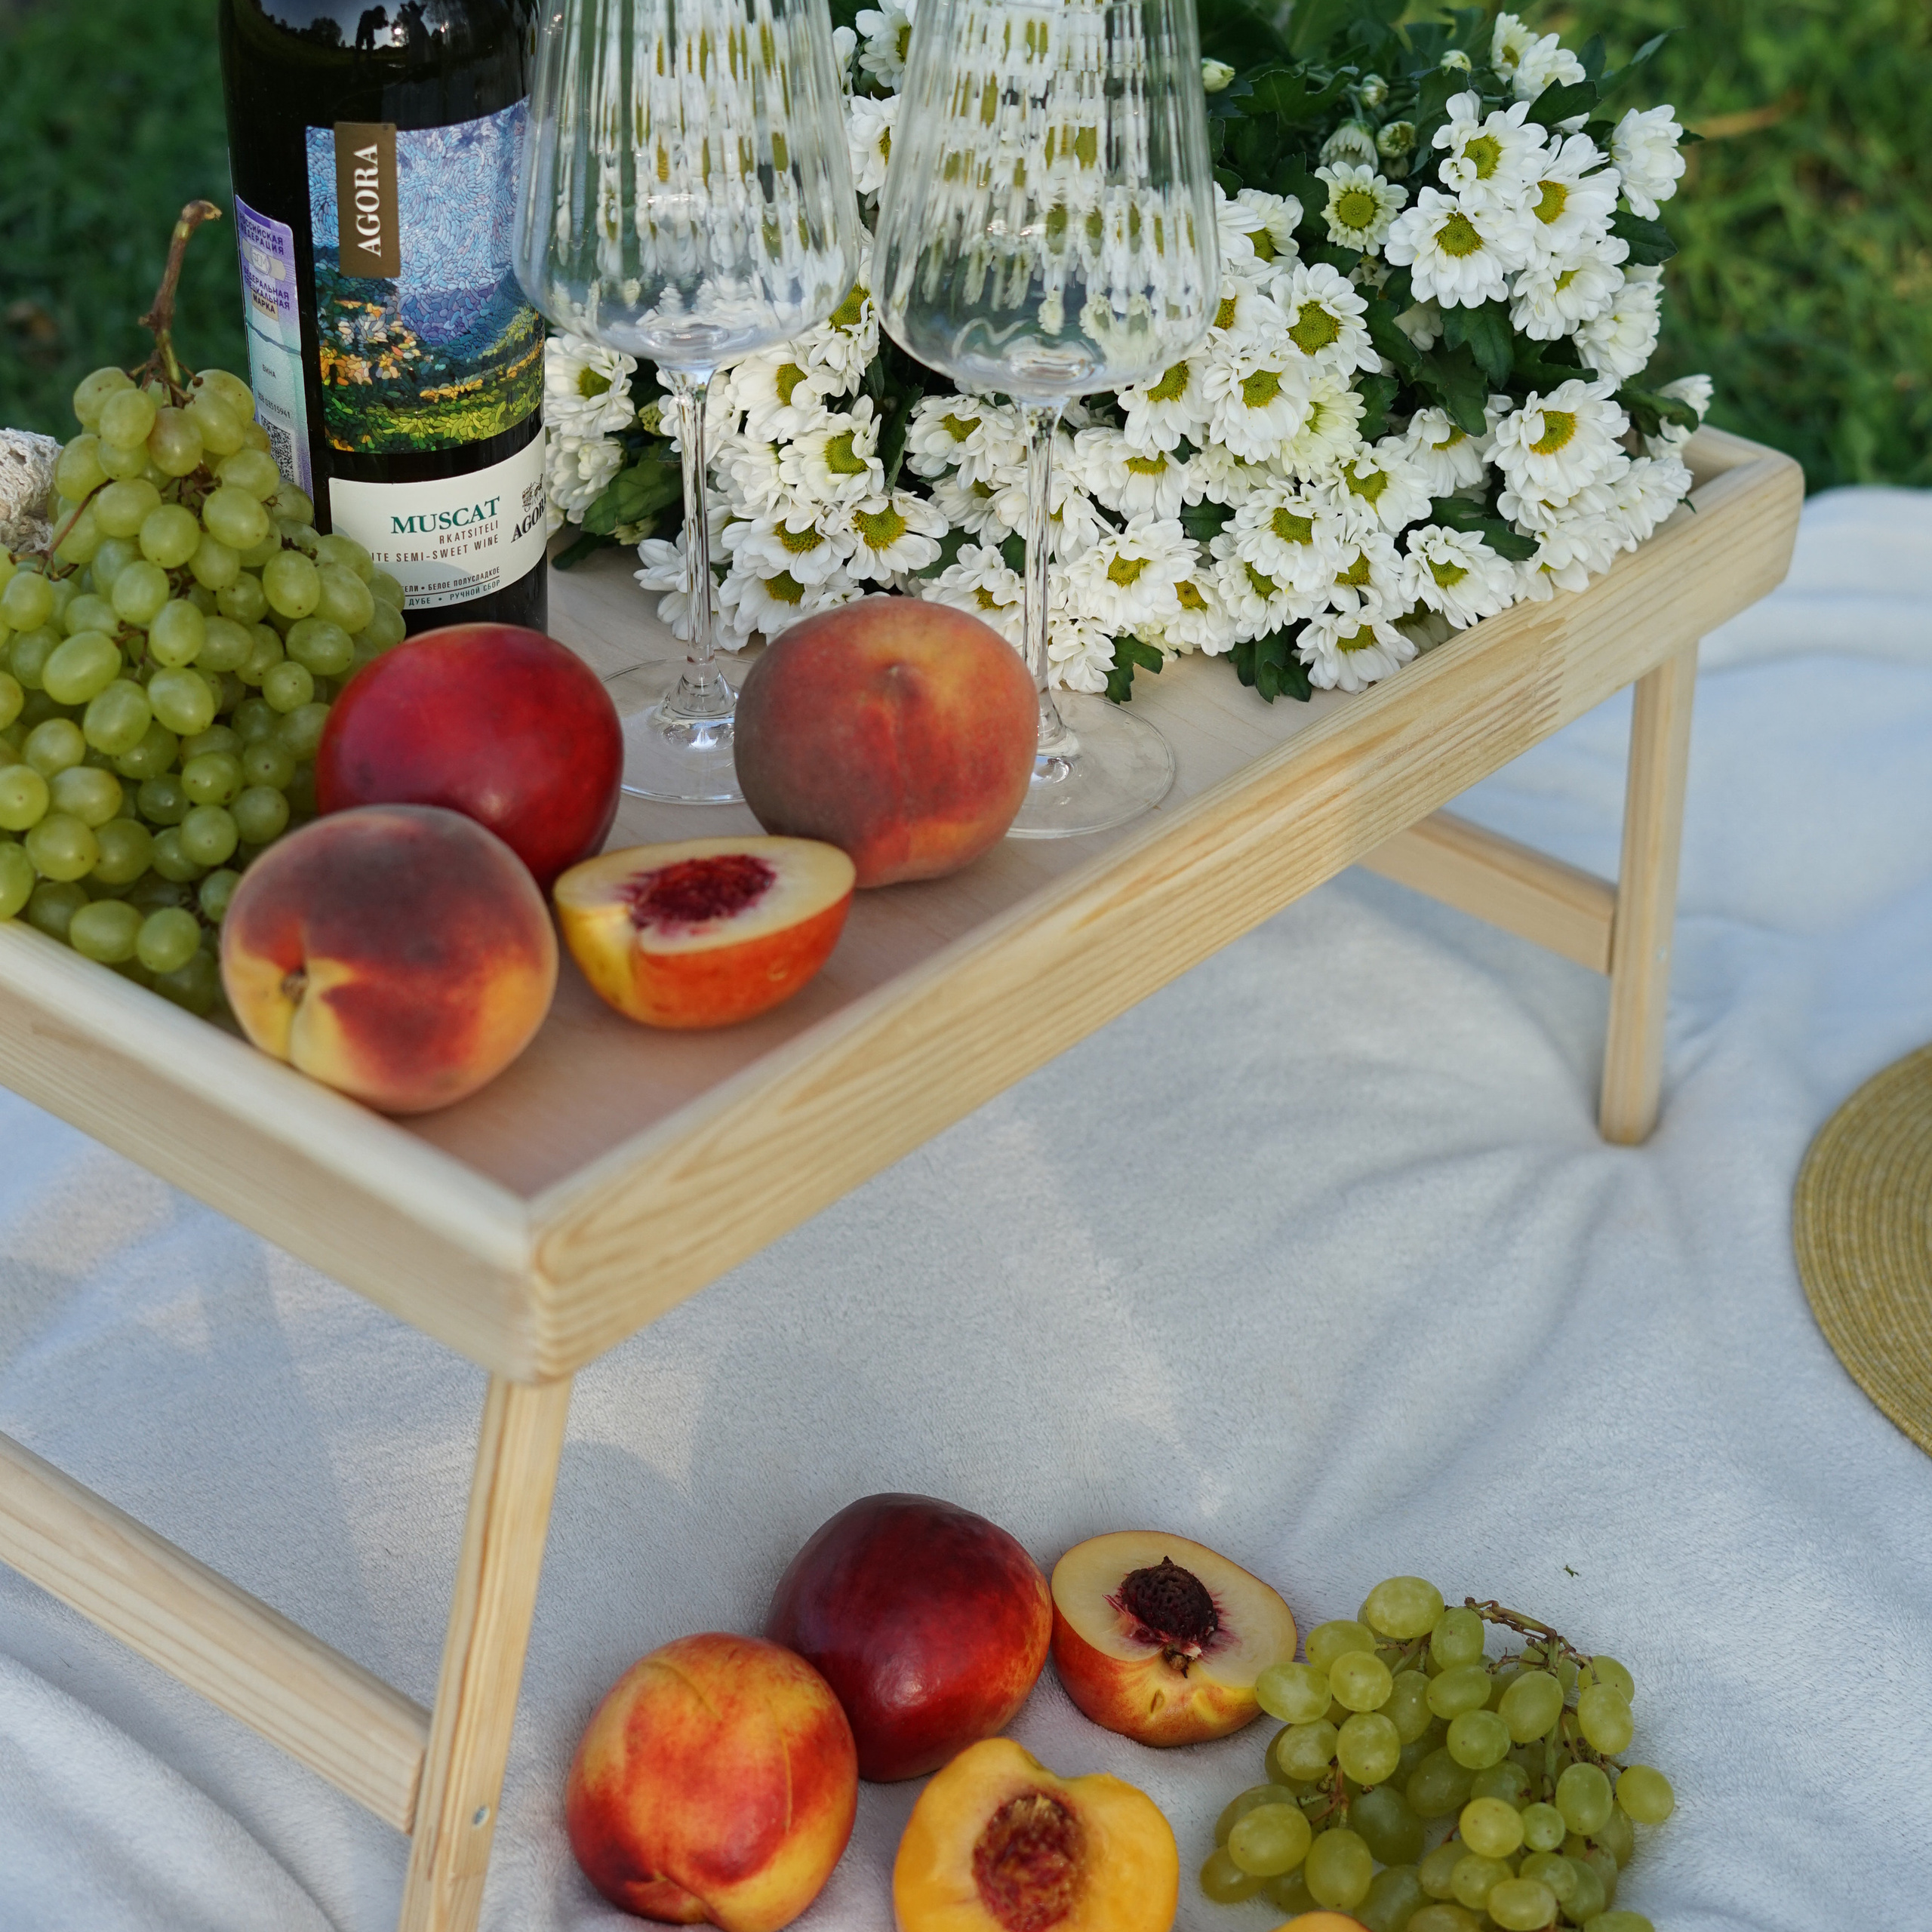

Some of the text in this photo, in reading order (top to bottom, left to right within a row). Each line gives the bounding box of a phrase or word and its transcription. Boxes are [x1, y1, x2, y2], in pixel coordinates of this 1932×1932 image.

[353, 143, 381, 257] AGORA
[253, 293, 275, 314] МАРКА
[390, 495, 500, 534] MUSCAT
[439, 520, 498, 544] RKATSITELI
[371, 534, 499, 562] ITE SEMI-SWEET WINE
[428, 581, 451, 591] БЕЛОЕ
[454, 566, 500, 587] ПОЛУСЛАДКОЕ
[408, 579, 500, 606] ДУБЕ РУЧНОЙ СБОР
